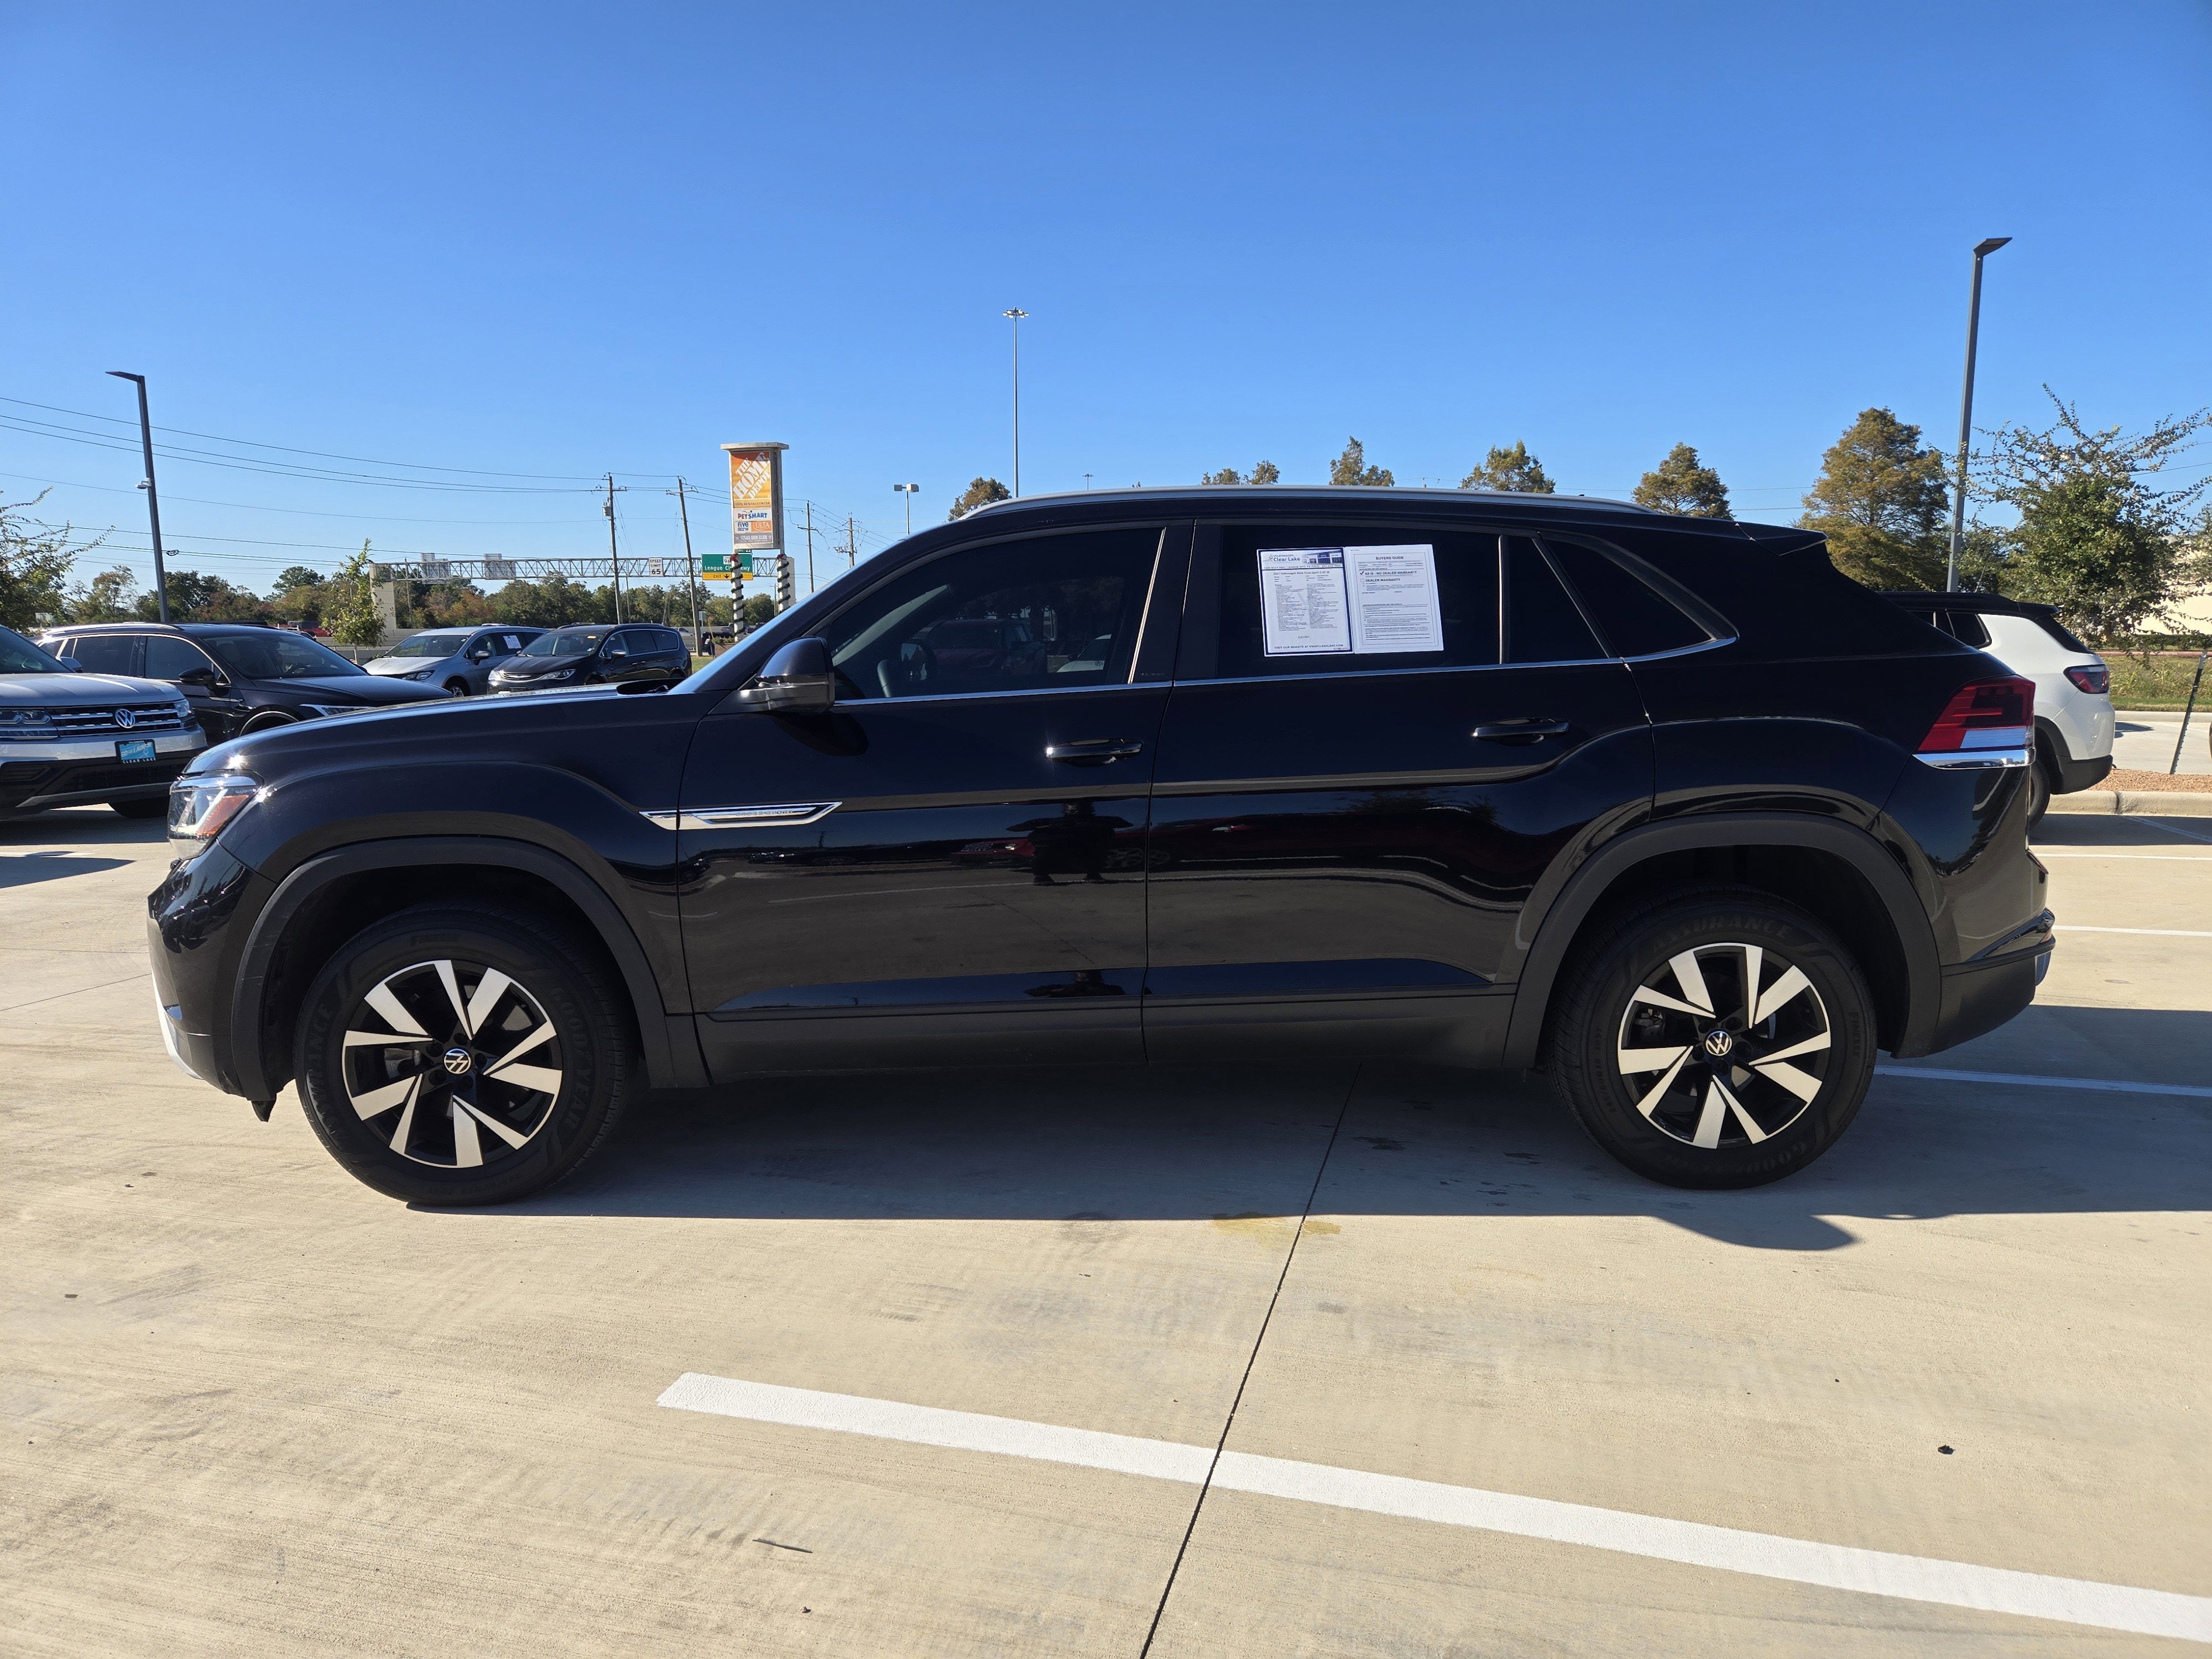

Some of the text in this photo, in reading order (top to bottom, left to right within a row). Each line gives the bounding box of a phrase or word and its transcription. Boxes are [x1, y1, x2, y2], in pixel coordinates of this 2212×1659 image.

[733, 452, 770, 499] HOME
[735, 457, 752, 477] THE
[748, 468, 770, 499] DEPOT
[1653, 915, 1793, 952] ASSURANCE
[554, 987, 593, 1130] GOODYEAR
